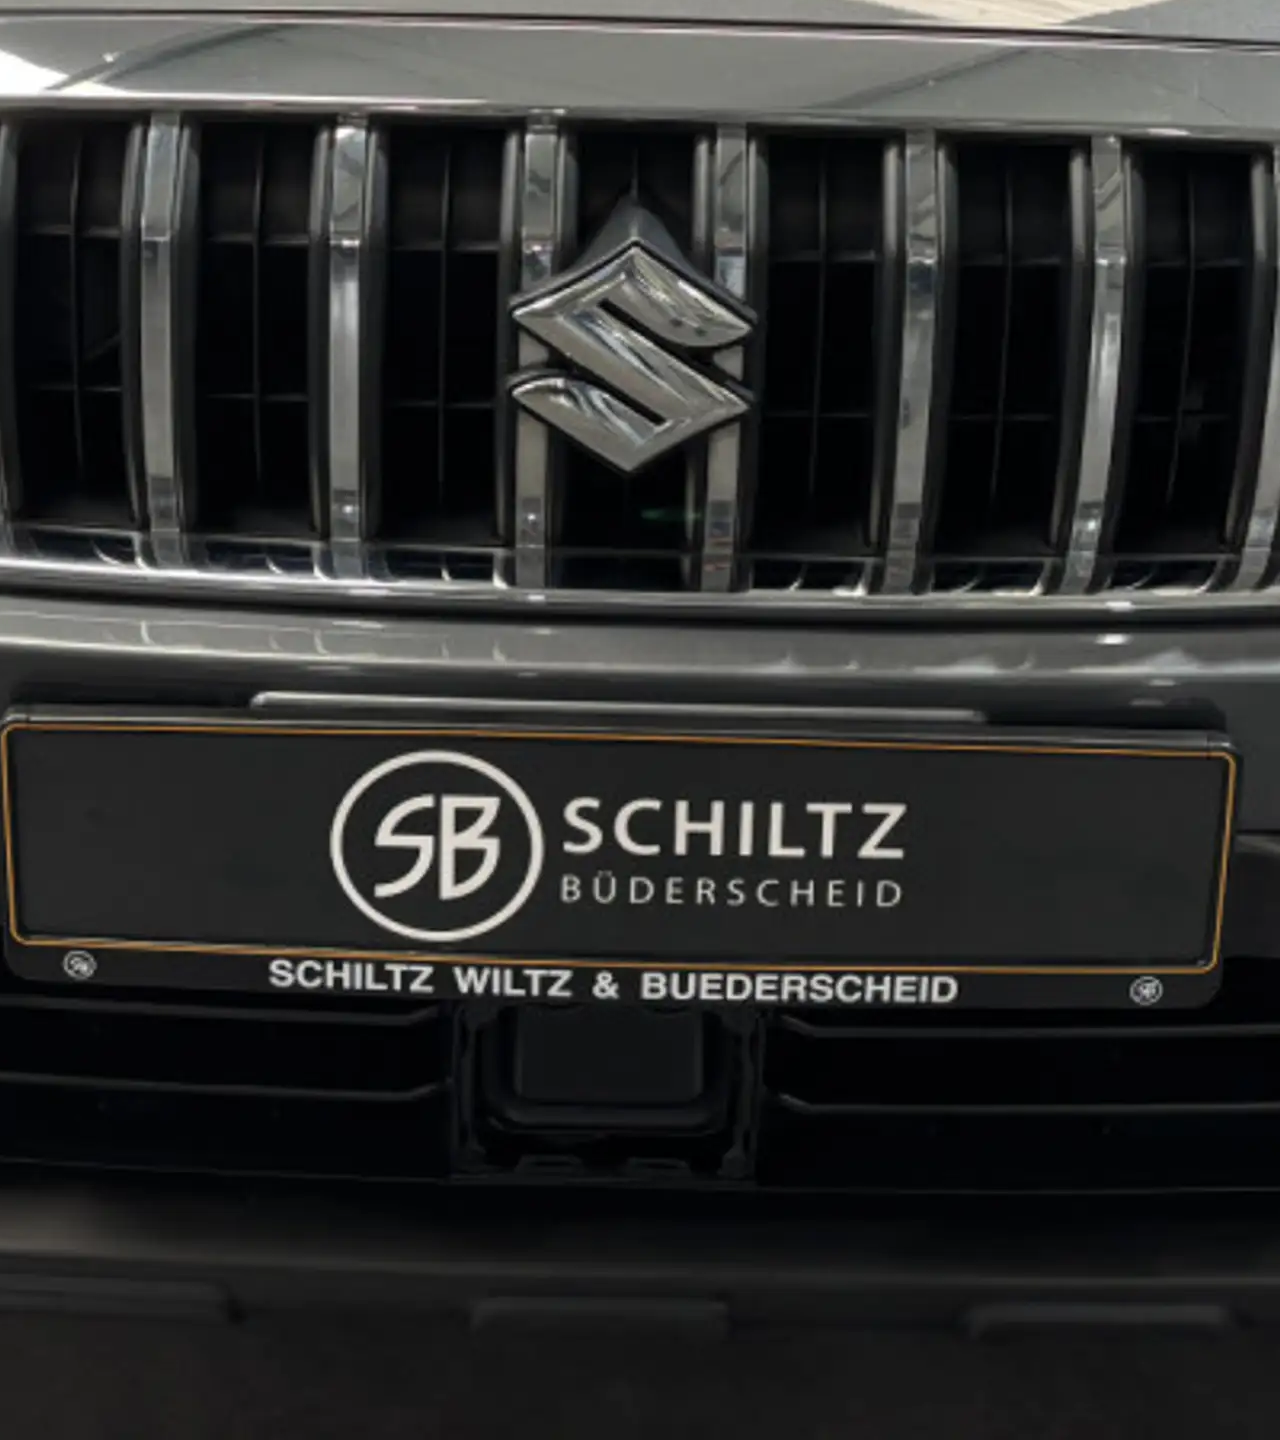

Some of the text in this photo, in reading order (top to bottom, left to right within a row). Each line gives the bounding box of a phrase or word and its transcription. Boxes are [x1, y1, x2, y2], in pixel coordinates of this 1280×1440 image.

[374, 794, 501, 900] SB
[562, 796, 908, 860] SCHILTZ
[560, 870, 903, 908] BÜDERSCHEID
[267, 959, 960, 1004] SCHILTZ WILTZ & BUEDERSCHEID
